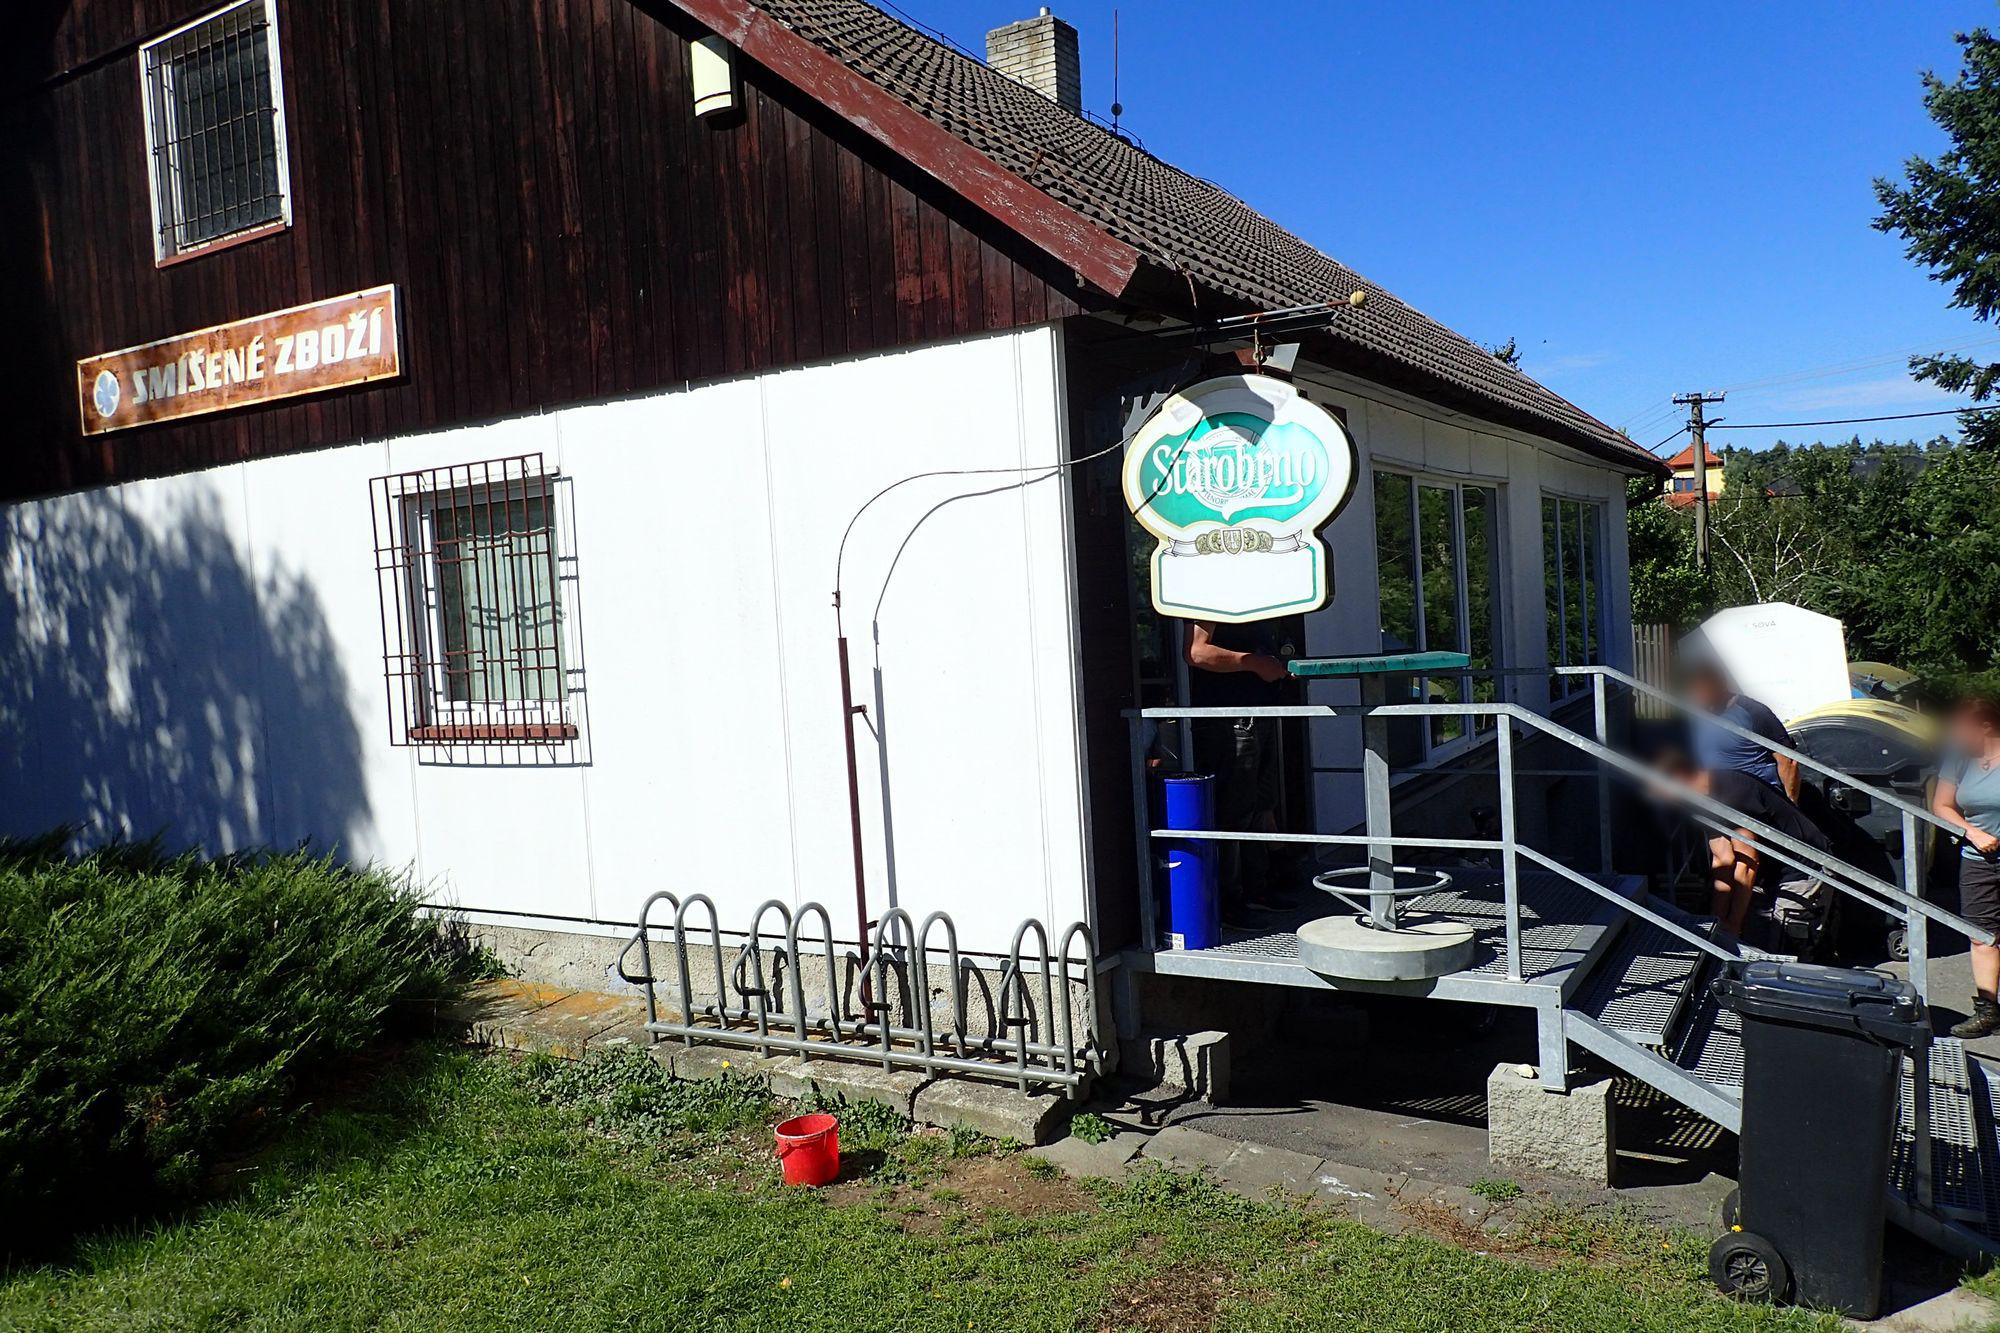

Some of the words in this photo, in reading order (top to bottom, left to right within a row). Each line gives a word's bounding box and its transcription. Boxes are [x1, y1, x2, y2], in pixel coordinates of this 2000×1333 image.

[132, 335, 265, 406] SMÍŠENÉ
[273, 306, 385, 376] ZBOŽÍ
[1153, 441, 1317, 500] Starobrno
